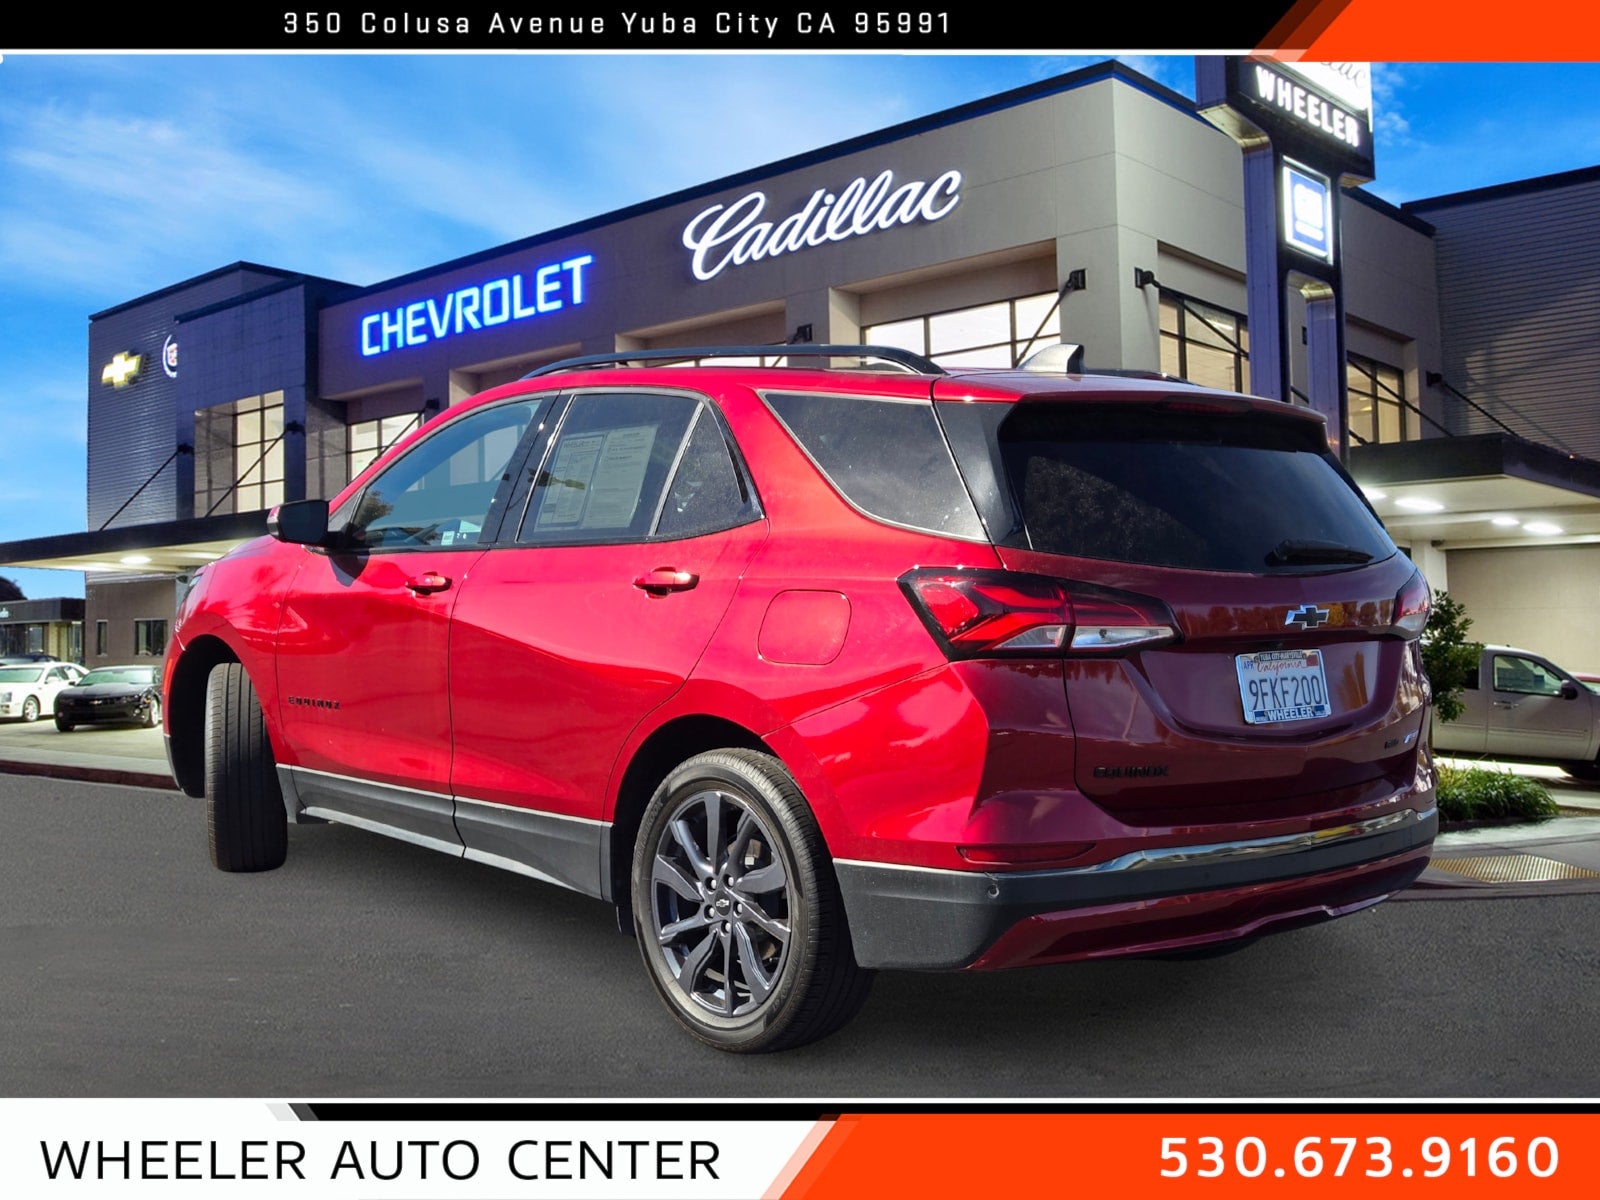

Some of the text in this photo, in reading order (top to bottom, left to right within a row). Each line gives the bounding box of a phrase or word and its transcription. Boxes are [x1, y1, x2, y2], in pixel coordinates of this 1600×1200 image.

[1256, 65, 1360, 147] WHEELER
[682, 169, 963, 281] Cadillac
[361, 255, 594, 356] CHEVROLET
[1257, 661, 1304, 675] California
[1250, 676, 1322, 709] 9FKF200
[1269, 709, 1314, 721] WHEELER
[1093, 766, 1169, 779] EQUINOX
